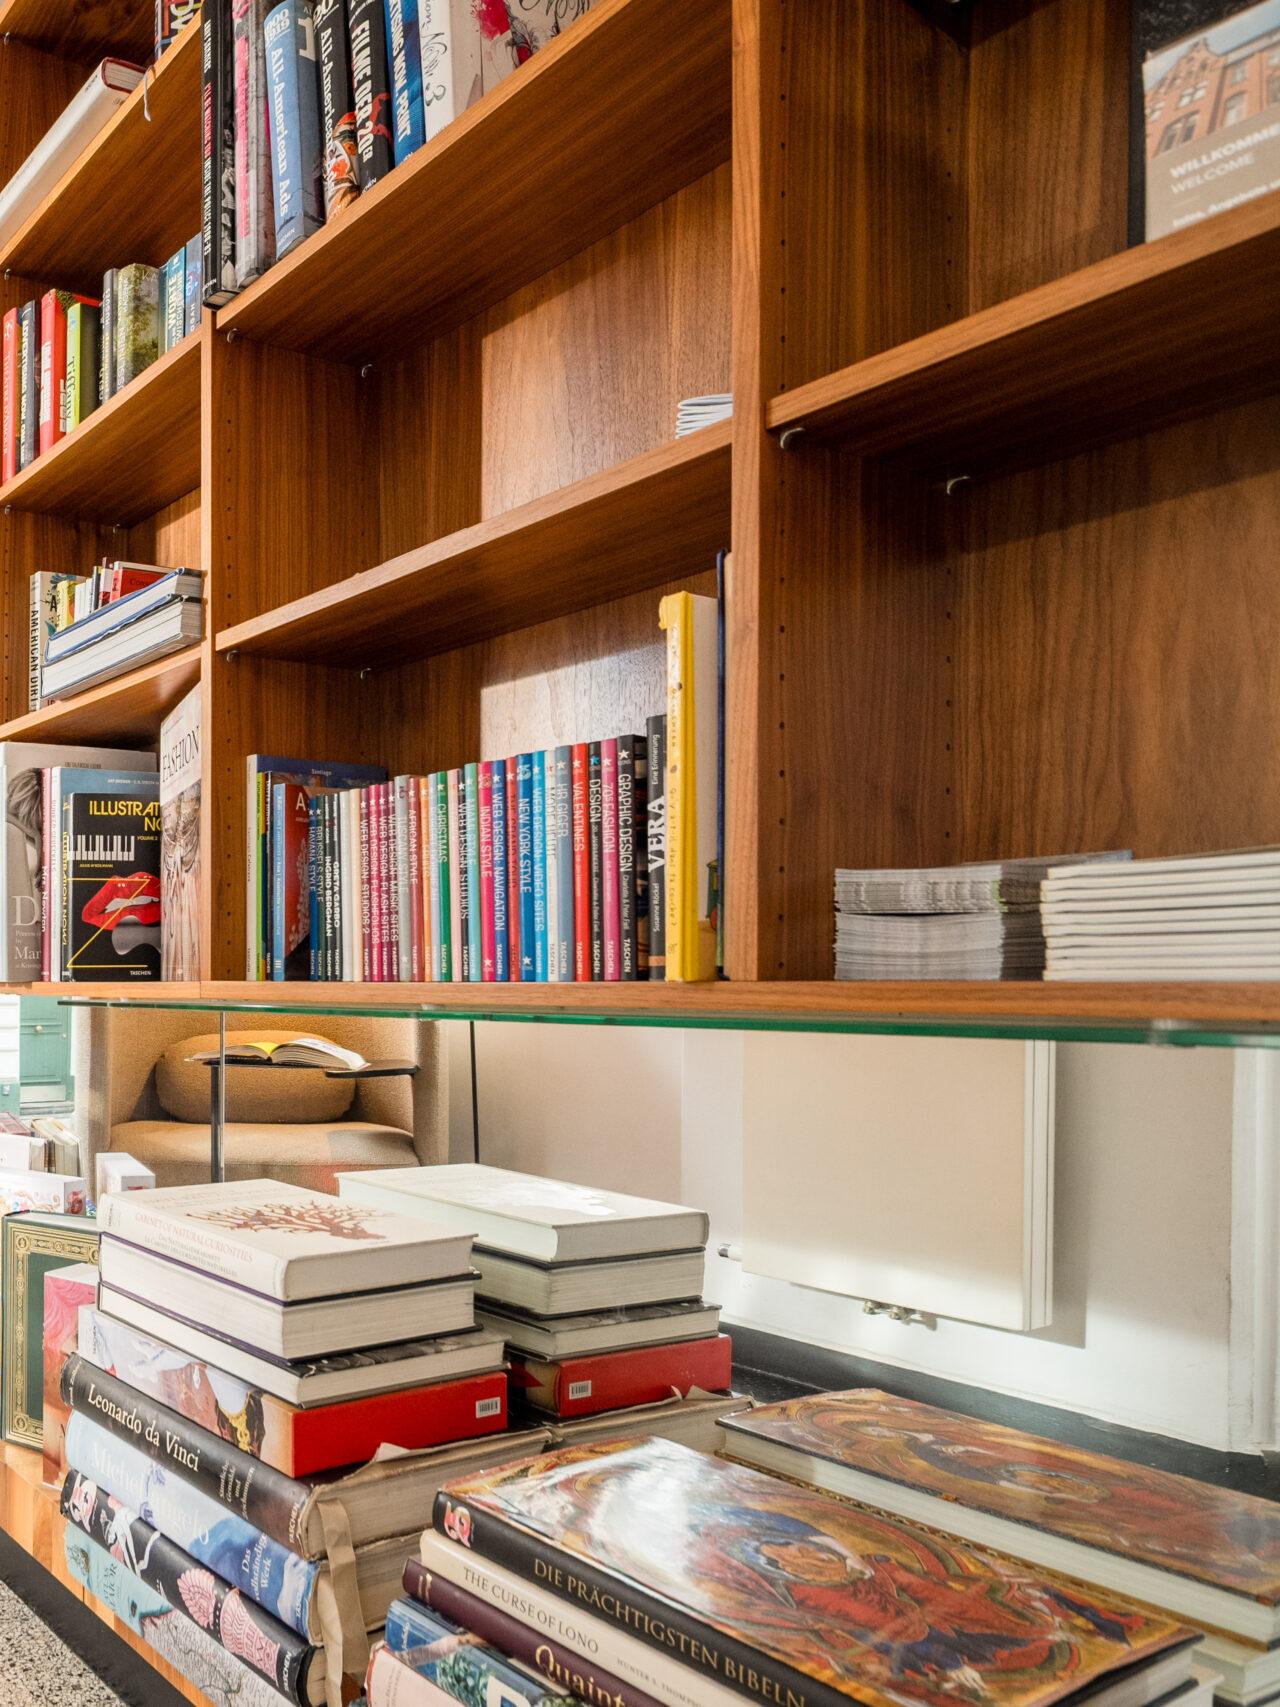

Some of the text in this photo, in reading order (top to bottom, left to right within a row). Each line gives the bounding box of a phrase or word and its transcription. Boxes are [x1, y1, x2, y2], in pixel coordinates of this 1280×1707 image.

[351, 20, 372, 123] FILME DER
[271, 48, 291, 218] All-American Ads
[396, 90, 411, 142] PRINT
[1171, 152, 1255, 194] WELCOME
[21, 319, 29, 394] ADVERTISING
[30, 609, 39, 672] AMERICAN
[162, 724, 199, 783] FASHION
[651, 734, 660, 785] Eine Erinnerung
[89, 800, 160, 817] ILLUSTRAT
[494, 792, 504, 818] WEB
[533, 787, 544, 812] WEB
[557, 783, 568, 799] HR
[589, 779, 601, 822] DESIGN
[619, 773, 632, 827] GRAPHIC
[360, 819, 369, 840] WEB
[370, 814, 379, 836] WEB
[380, 816, 389, 838] WEB
[389, 814, 399, 838] WEB
[409, 809, 417, 851] AFRICAN
[437, 803, 447, 863] CHRISTMAS
[459, 803, 468, 825] WEB
[557, 802, 568, 838] GIGER
[573, 781, 584, 850] VALENTINES
[603, 803, 615, 853] FASHION
[647, 795, 666, 873] VERA
[481, 805, 492, 878] INDIAN STYLE
[519, 798, 531, 894] NEW YORK STYLE
[619, 828, 632, 872] DESIGN
[315, 826, 323, 903] BRUSSELS STYLE
[409, 853, 417, 885] STYLE
[533, 863, 544, 898] VIDEO
[360, 883, 369, 925] STUDIOS
[370, 879, 379, 945] FLASHFOLIOS
[380, 881, 389, 912] FLASH
[389, 880, 399, 911] MUSIC
[459, 875, 468, 919] STUDIOS
[494, 866, 504, 931] NAVIGATION
[533, 901, 544, 932] SITES
[380, 914, 389, 942] SITES
[389, 912, 399, 942] SITES
[652, 906, 660, 932] Susanne
[623, 939, 631, 972] TASCHEN
[135, 1212, 160, 1229] CABINET
[173, 1225, 204, 1244] NATURAL
[88, 1383, 200, 1472] Leonardo da Vinci
[289, 1502, 300, 1544] TASCHEN
[241, 1547, 251, 1573] Das
[260, 1557, 272, 1590] Werk
[462, 1566, 599, 1655] THE CURSE OF LONO
[533, 1558, 806, 1707] DIE PRÄCHTIGSTEN BIBELN
[283, 1650, 293, 1693] TASCHEN
[535, 1644, 625, 1707] Quaint
